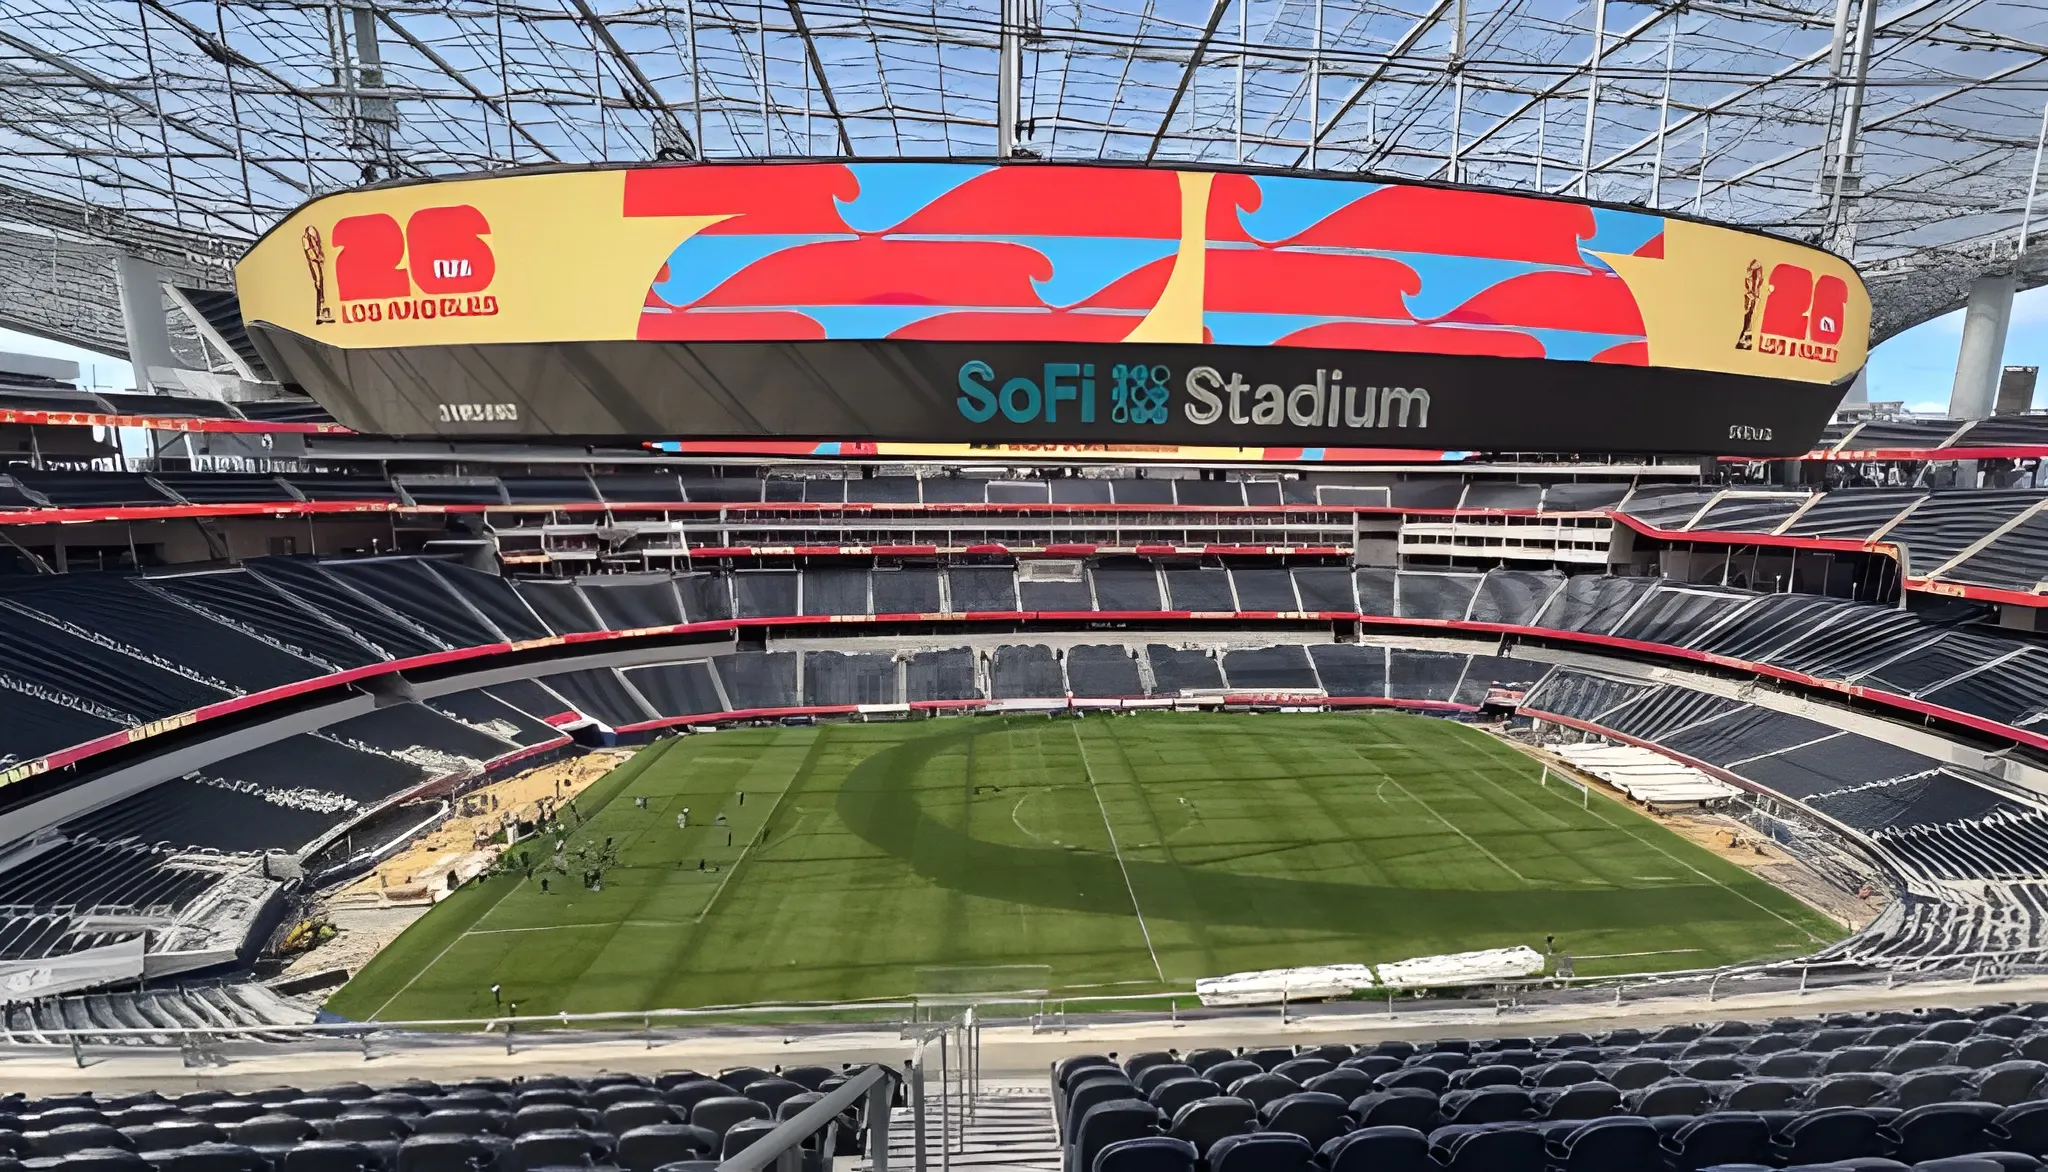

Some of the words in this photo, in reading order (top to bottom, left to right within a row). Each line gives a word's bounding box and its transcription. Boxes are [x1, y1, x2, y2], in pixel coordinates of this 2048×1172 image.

[332, 204, 496, 301] 26
[957, 360, 1096, 423] SoFi
[1184, 366, 1430, 428] Stadium
